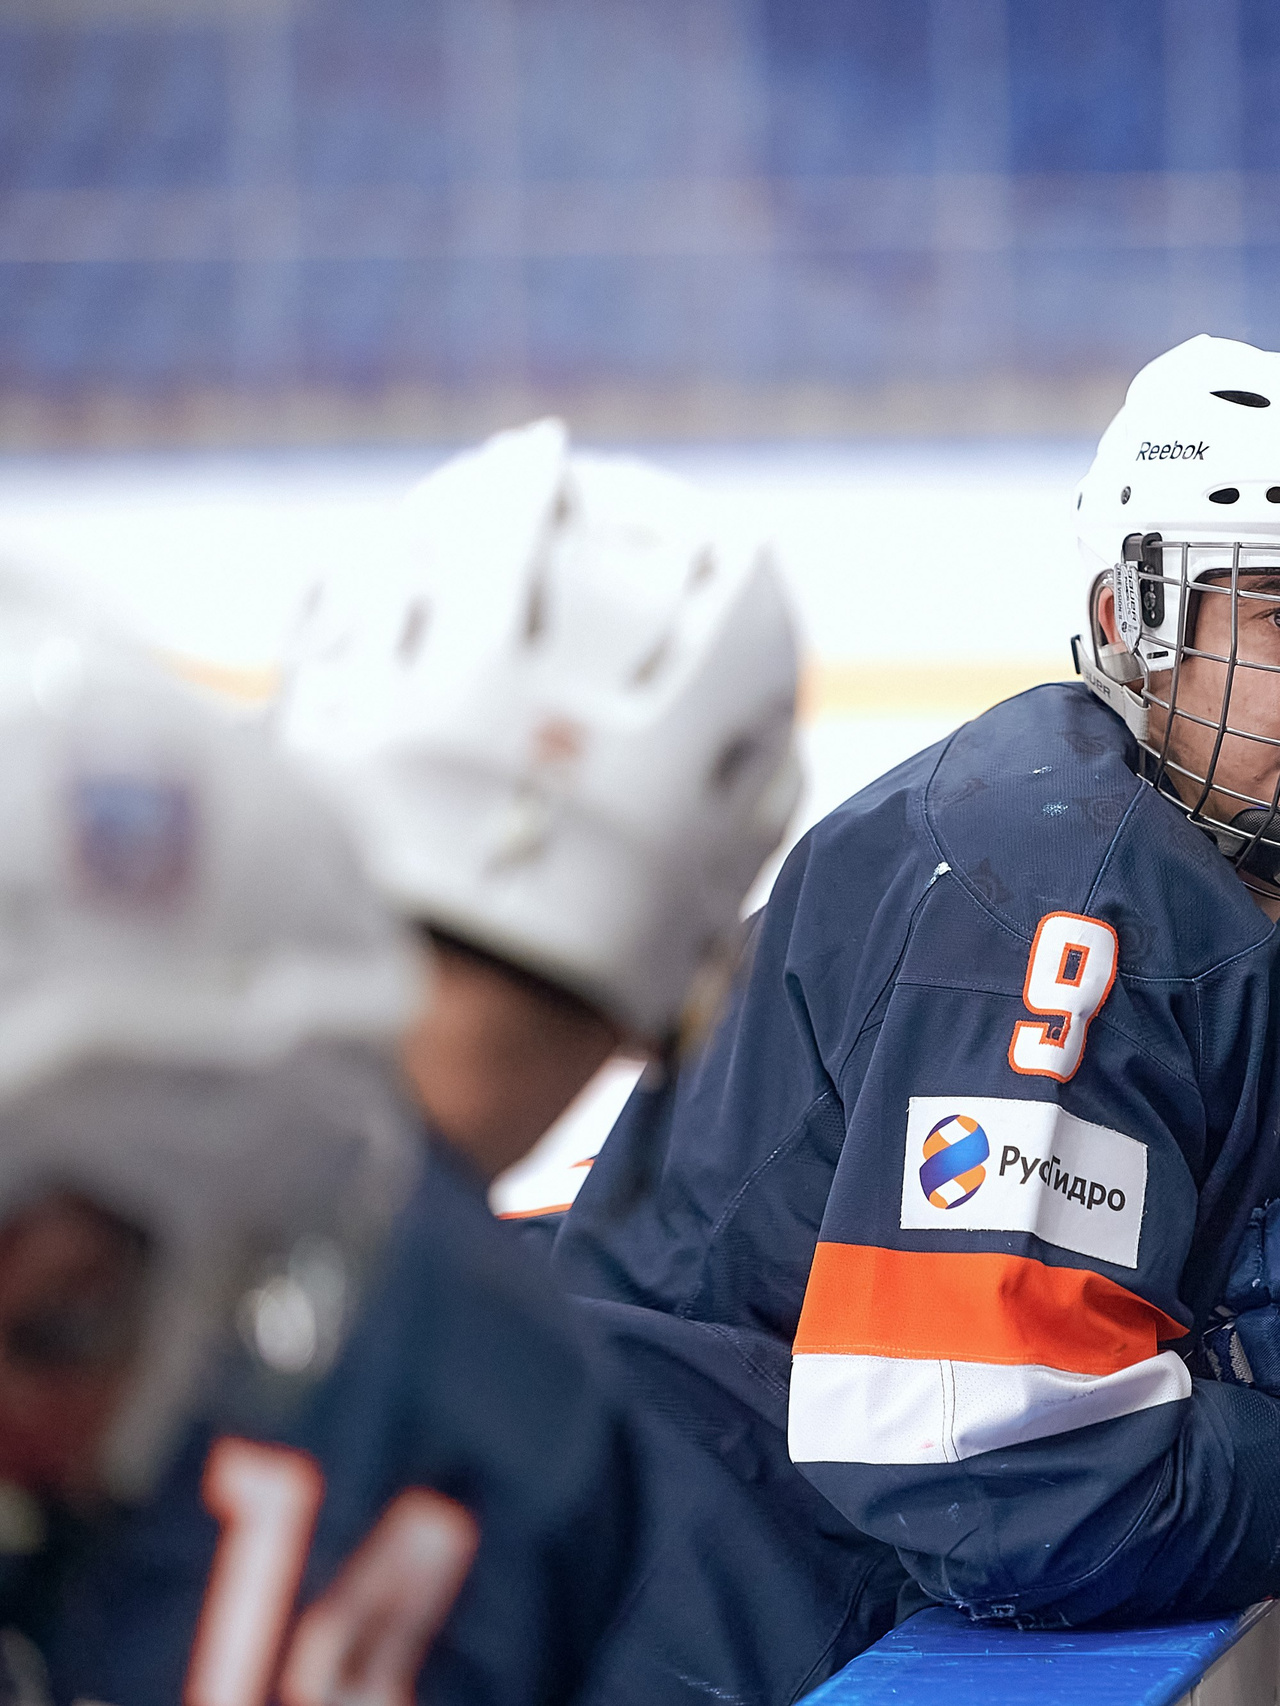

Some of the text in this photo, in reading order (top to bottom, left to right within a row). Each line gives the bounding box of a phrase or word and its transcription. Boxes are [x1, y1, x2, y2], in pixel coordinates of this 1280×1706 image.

[1135, 440, 1210, 461] Reebok
[1008, 911, 1119, 1083] 9
[998, 1145, 1126, 1211] РусГидро
[183, 1433, 480, 1706] 14
